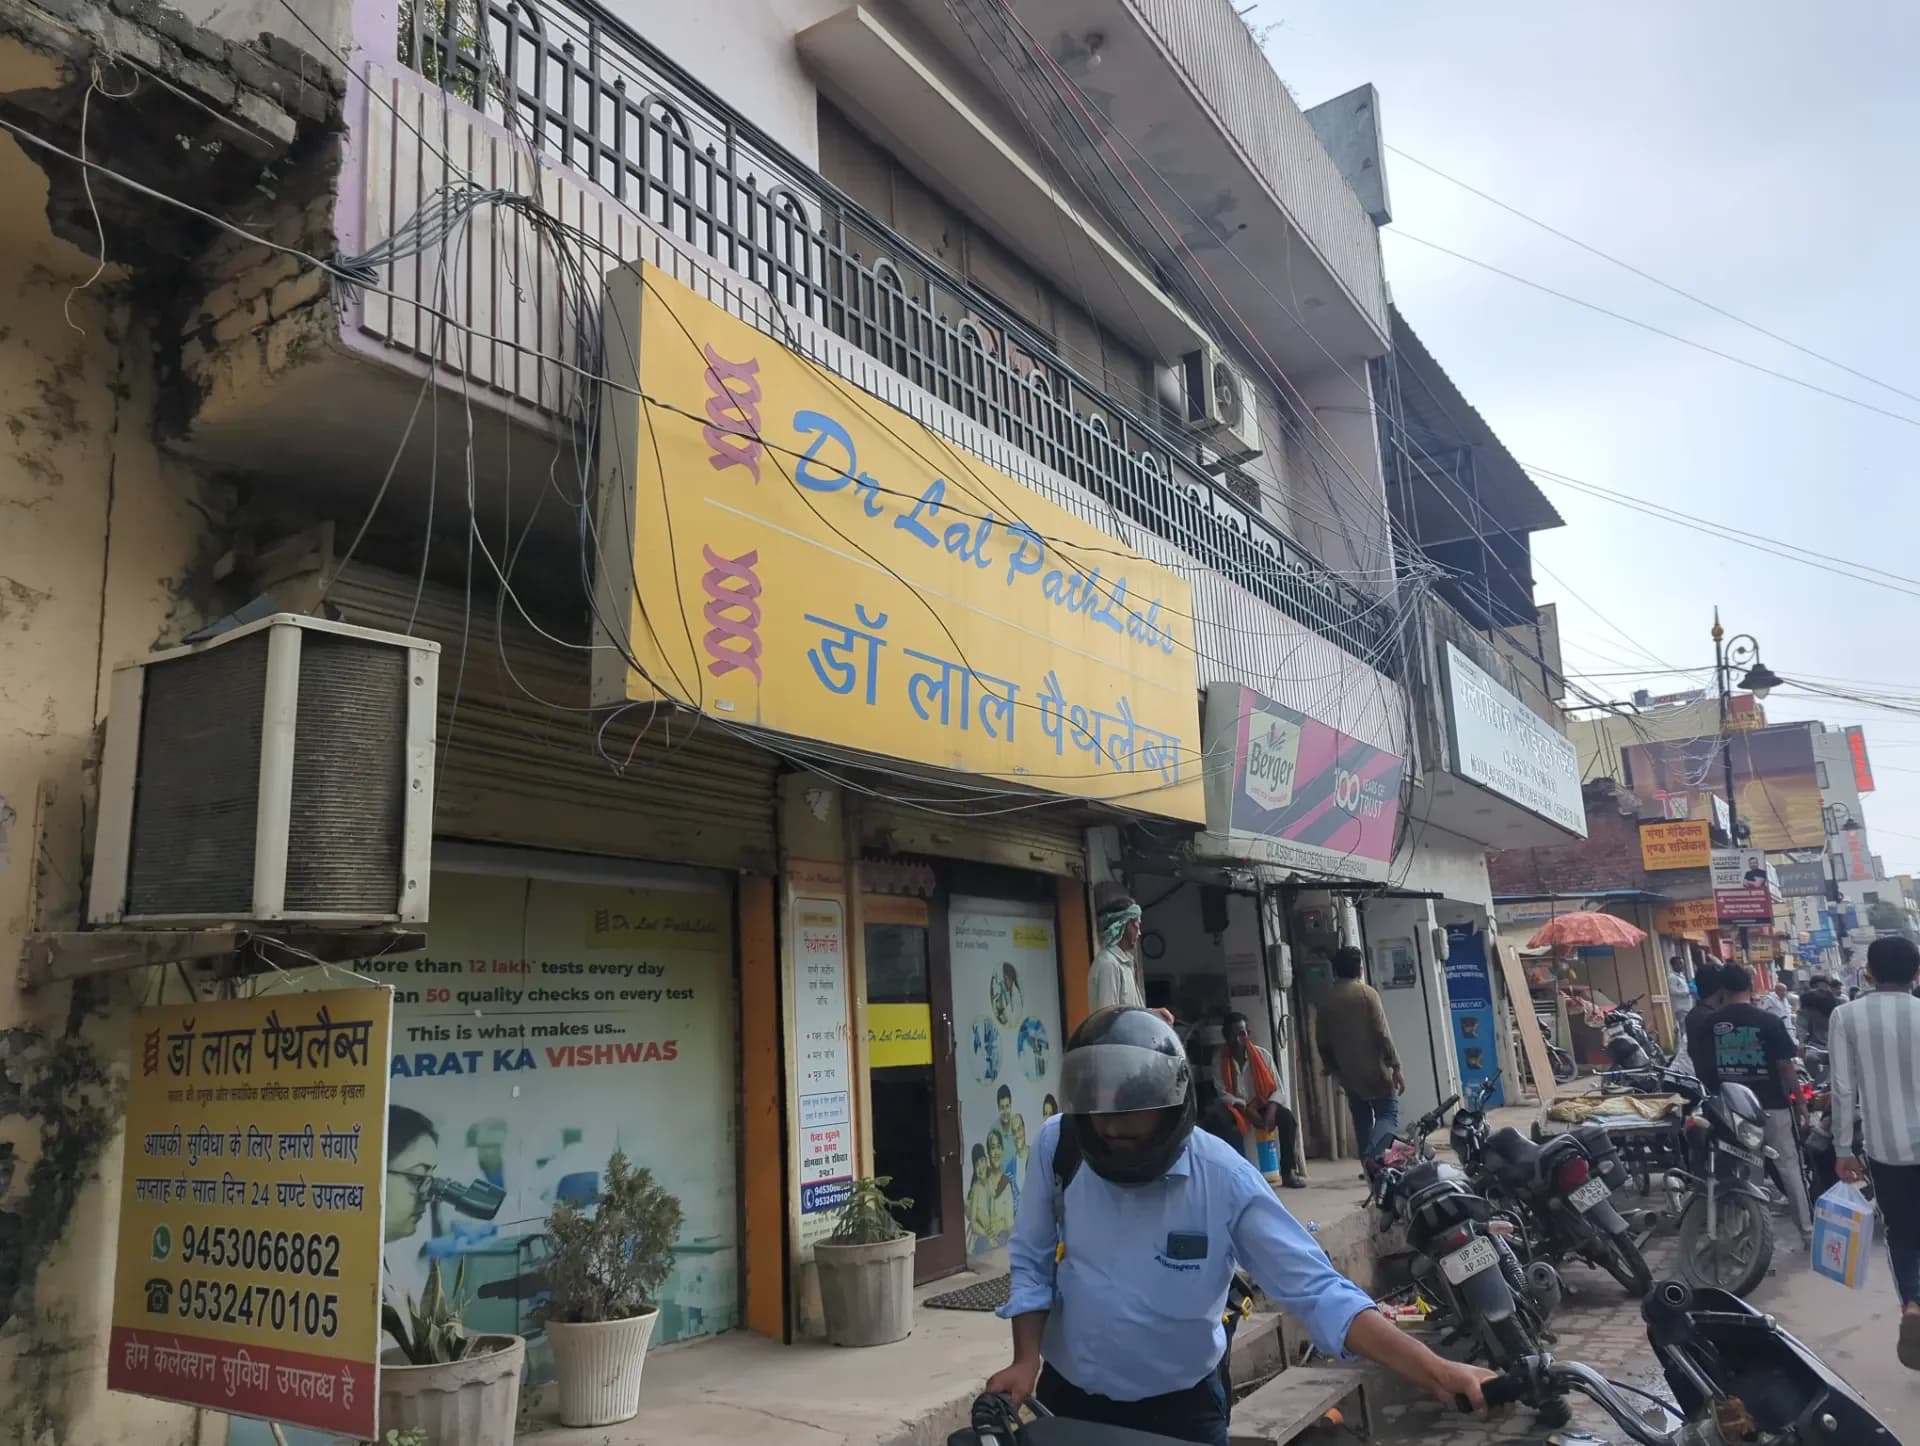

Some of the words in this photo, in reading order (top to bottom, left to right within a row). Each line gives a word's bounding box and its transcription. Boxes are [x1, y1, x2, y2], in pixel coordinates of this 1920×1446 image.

[792, 409, 885, 519] Dr
[895, 478, 992, 568] Lal
[1004, 522, 1175, 657] PathLabs
[803, 602, 888, 705] डॉ
[903, 647, 1019, 743] लाल
[1036, 669, 1181, 784] पैथलैब्स
[1251, 742, 1294, 792] Berger
[1333, 767, 1360, 812] 100
[1360, 795, 1384, 819] TRUST
[352, 958, 408, 974] More
[416, 958, 462, 974] than
[469, 959, 487, 974] 12
[541, 960, 584, 975] tests
[588, 963, 633, 978] every
[637, 961, 665, 978] day
[394, 990, 420, 1003] an
[426, 988, 450, 1003] 50
[457, 986, 523, 1008] quality
[527, 985, 590, 1002] checks
[594, 989, 615, 1001] on
[619, 988, 662, 1004] every
[665, 986, 695, 1000] test
[167, 1016, 196, 1077] डॉ
[202, 1029, 257, 1075] लाल
[262, 1005, 374, 1070] पैथलैब्स
[407, 1025, 451, 1042] This
[456, 1023, 473, 1041] is
[477, 1022, 526, 1040] what
[531, 1021, 590, 1038] makes
[593, 1022, 626, 1036] us...
[389, 1050, 484, 1078] ARAT
[492, 1048, 537, 1073] KA
[545, 1039, 679, 1068] VISHWAS
[144, 1124, 182, 1155] आपकी
[187, 1124, 225, 1166] सुविधा
[229, 1126, 243, 1155] के
[247, 1124, 273, 1159] लिए
[278, 1124, 314, 1160] हमारी
[135, 1178, 172, 1203] सप्ताह
[175, 1170, 189, 1202] के
[192, 1178, 217, 1204] सात
[221, 1171, 247, 1205] दिन
[250, 1181, 270, 1206] 24
[276, 1174, 307, 1208] घण्टे
[312, 1182, 365, 1212] उपलब्ध
[182, 1224, 340, 1278] 9453066862
[178, 1278, 339, 1339] 9532470105
[125, 1332, 149, 1371] होम
[153, 1337, 217, 1383] कलेक्शन
[221, 1348, 271, 1398] सुविधा
[275, 1364, 336, 1404] उपलब्ध
[341, 1364, 355, 1410] है
